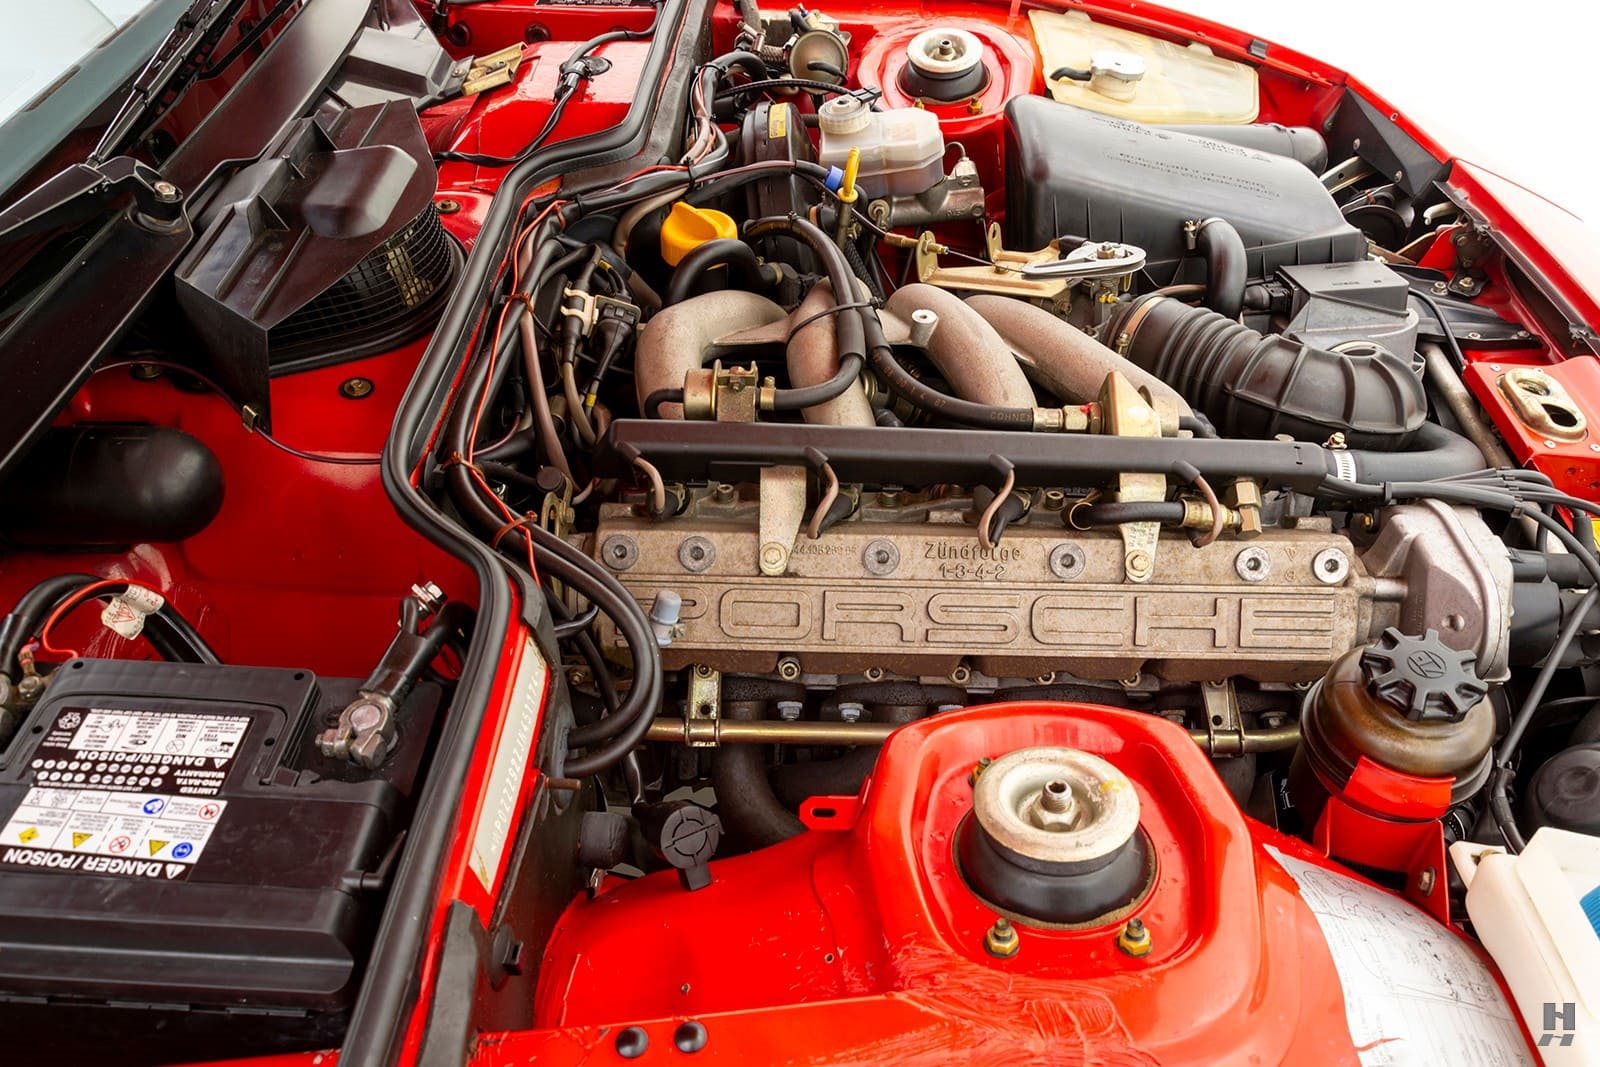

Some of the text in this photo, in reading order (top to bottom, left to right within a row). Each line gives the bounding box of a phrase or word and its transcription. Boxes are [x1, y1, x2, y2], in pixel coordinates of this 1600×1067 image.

[924, 541, 1021, 562] Zündfolge
[938, 564, 1006, 580] 1-3-4-2
[75, 750, 207, 767] DANGER/POISON
[173, 769, 226, 779] WARRANTY
[175, 778, 223, 788] PRO-RATA
[179, 787, 219, 796] LIMITED
[84, 856, 163, 877] DANGER
